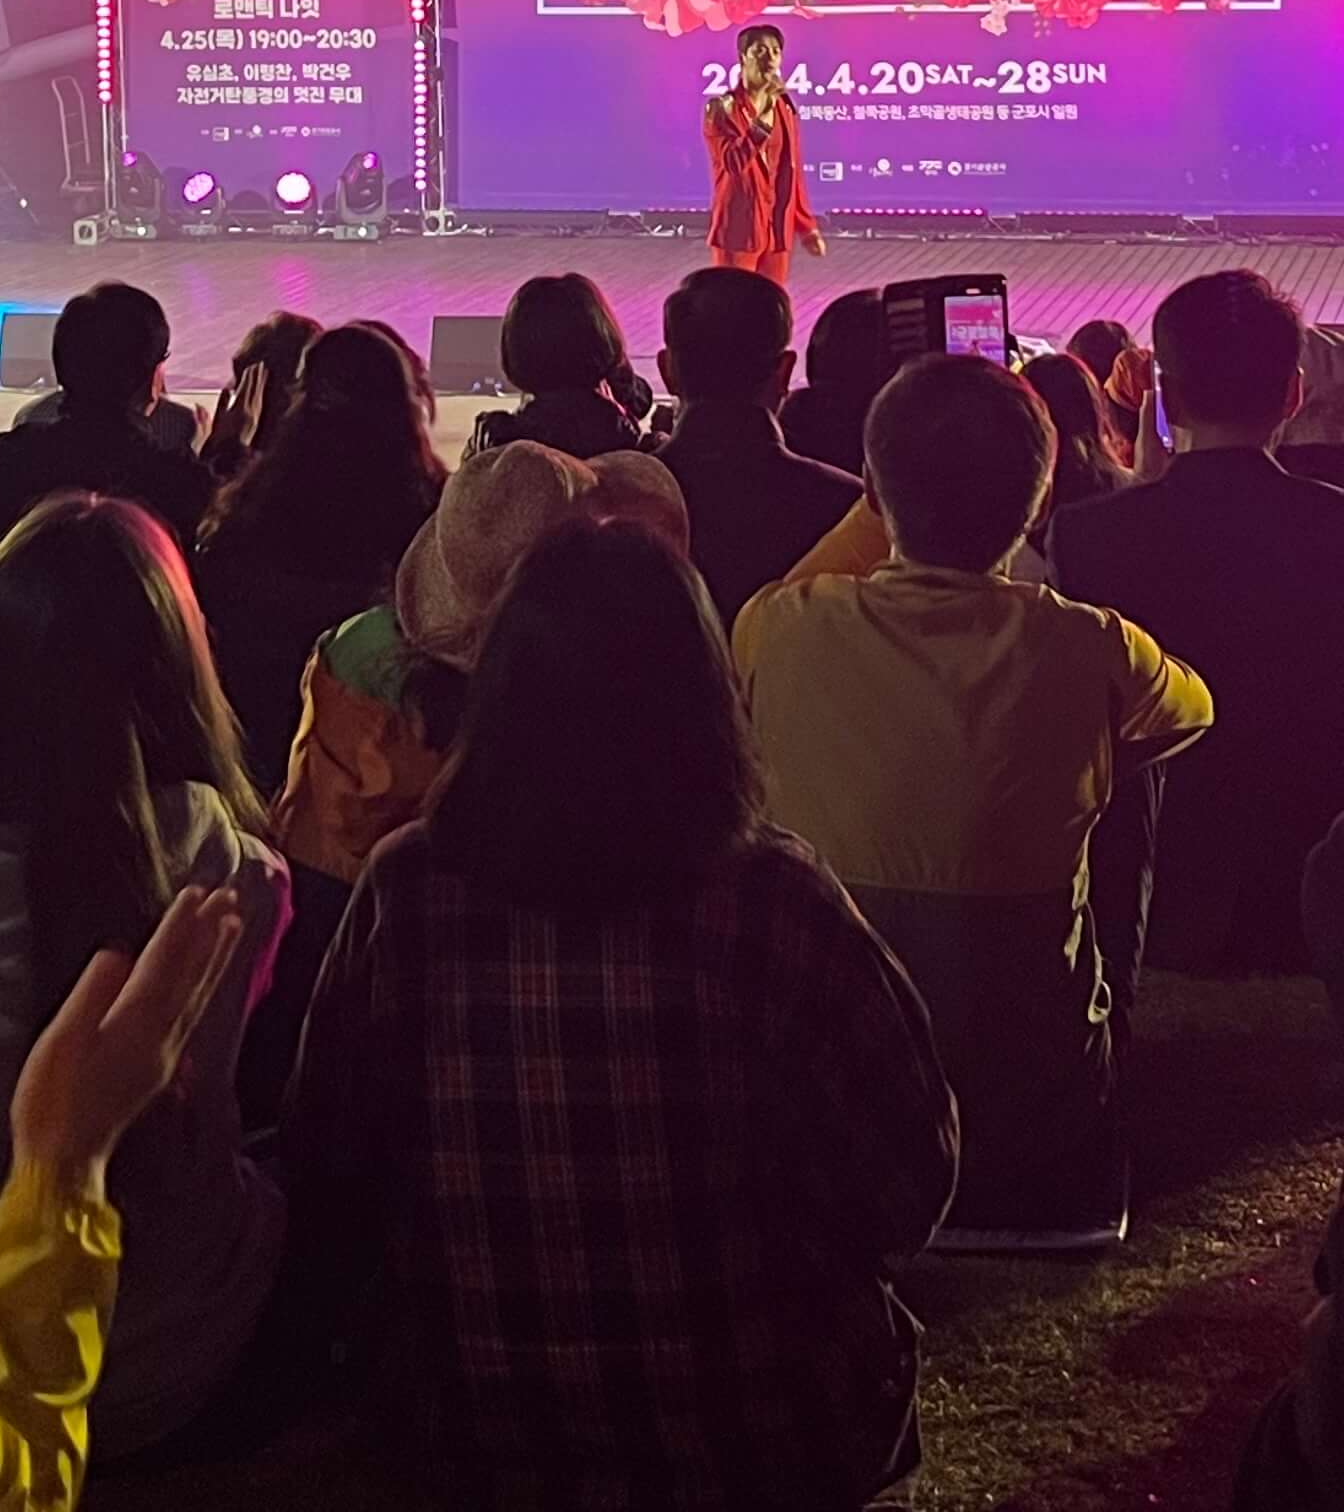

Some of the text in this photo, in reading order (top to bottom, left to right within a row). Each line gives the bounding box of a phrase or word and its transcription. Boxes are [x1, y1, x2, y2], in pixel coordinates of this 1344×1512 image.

[160, 28, 377, 50] 4.25(목) 19:00~20:30
[302, 63, 353, 81] 박건우
[177, 86, 364, 105] 자전거탄풍경의 멋진 무대
